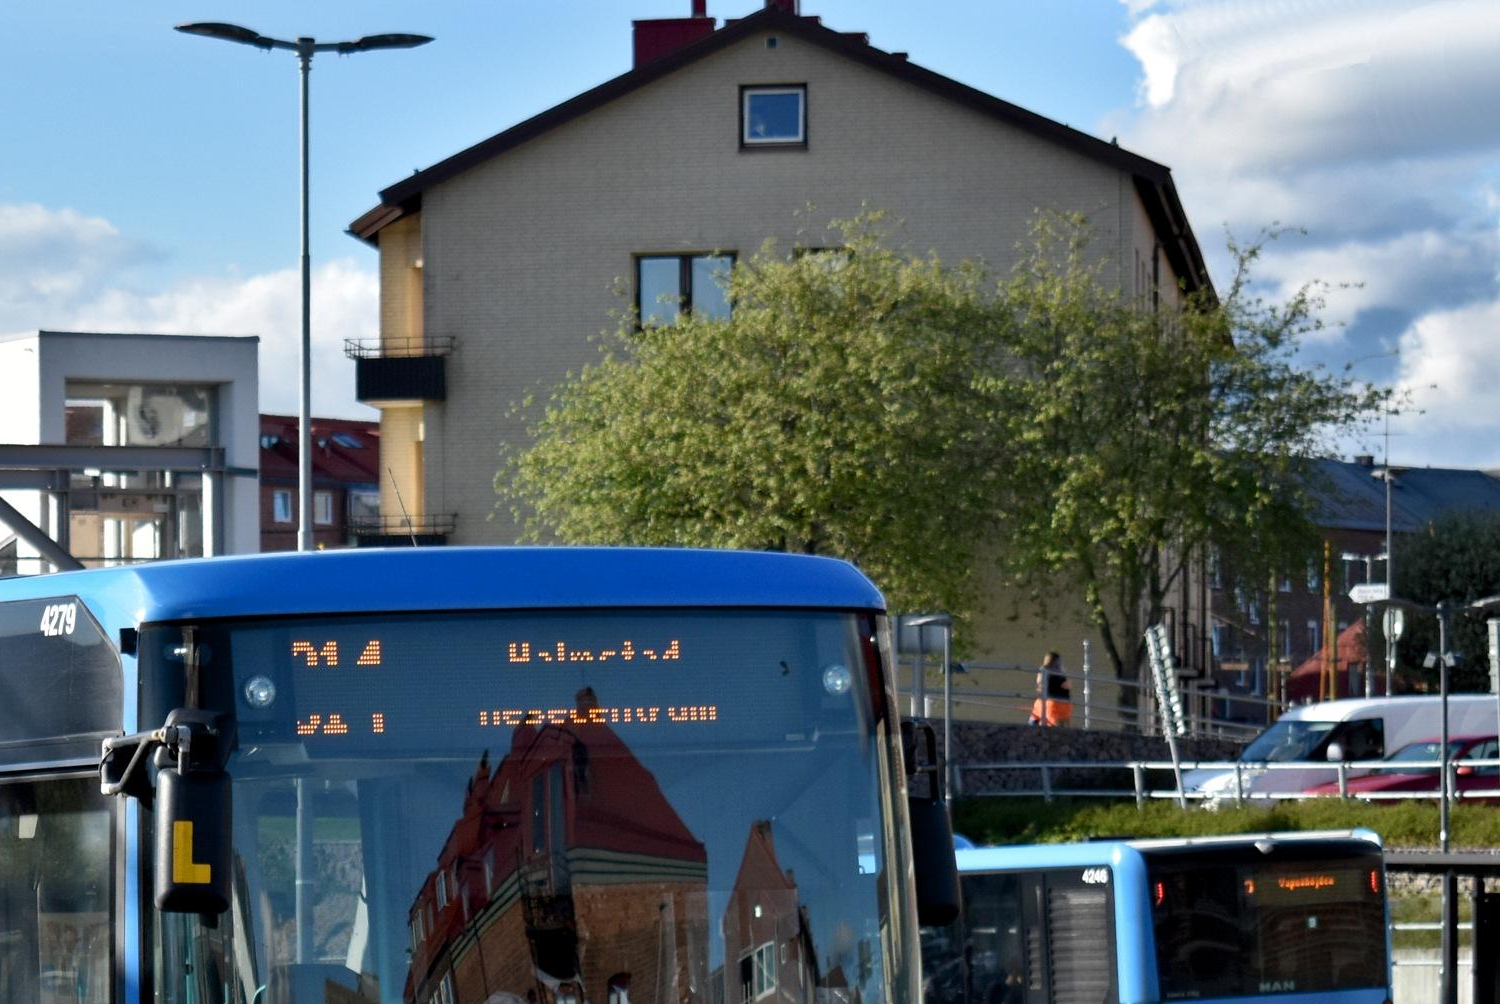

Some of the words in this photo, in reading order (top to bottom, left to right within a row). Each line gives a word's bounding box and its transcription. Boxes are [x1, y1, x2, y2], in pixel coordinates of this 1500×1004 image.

[40, 603, 76, 636] 4279
[1082, 869, 1108, 884] 4246
[1259, 981, 1295, 993] MAN
